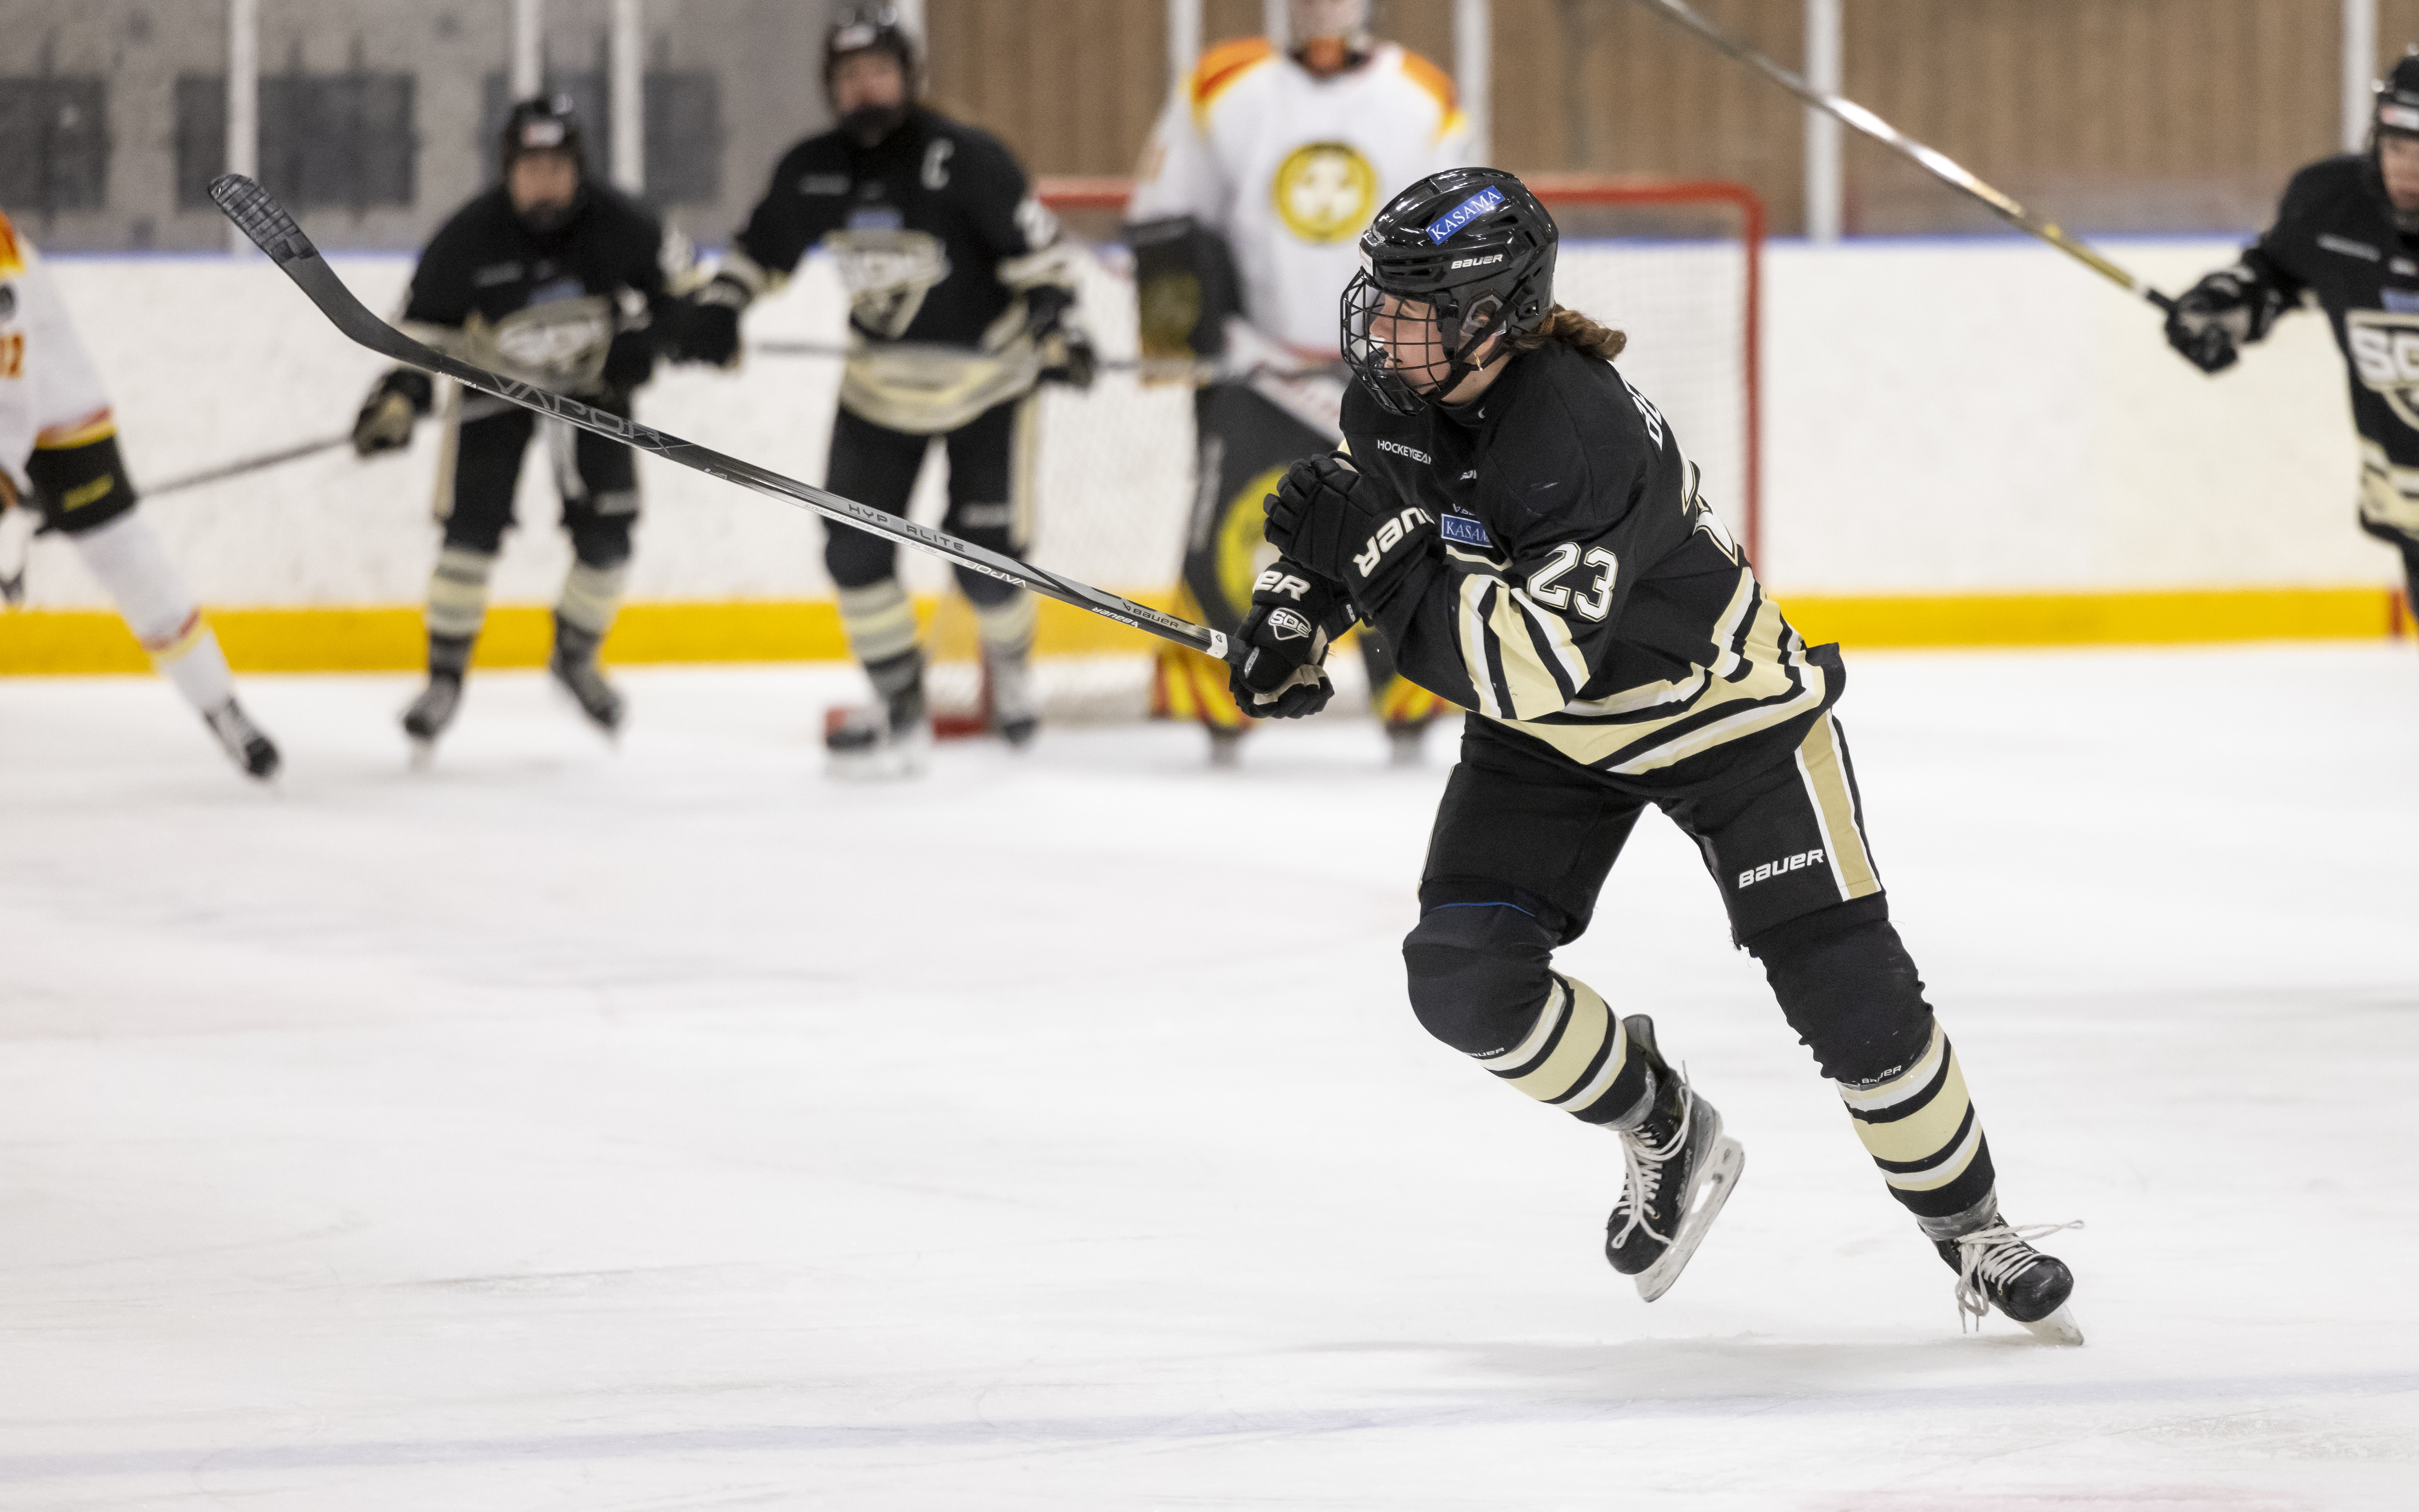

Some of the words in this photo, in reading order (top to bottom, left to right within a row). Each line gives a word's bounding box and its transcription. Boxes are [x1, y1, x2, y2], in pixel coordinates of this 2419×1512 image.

[1431, 191, 1501, 241] KASAMA
[1451, 254, 1503, 269] BAUER
[962, 559, 1026, 588] VAPOR
[1527, 543, 1618, 622] 23
[1092, 607, 1133, 624] BAUER
[1133, 608, 1179, 628] BAUER
[1739, 849, 1824, 889] BAUER
